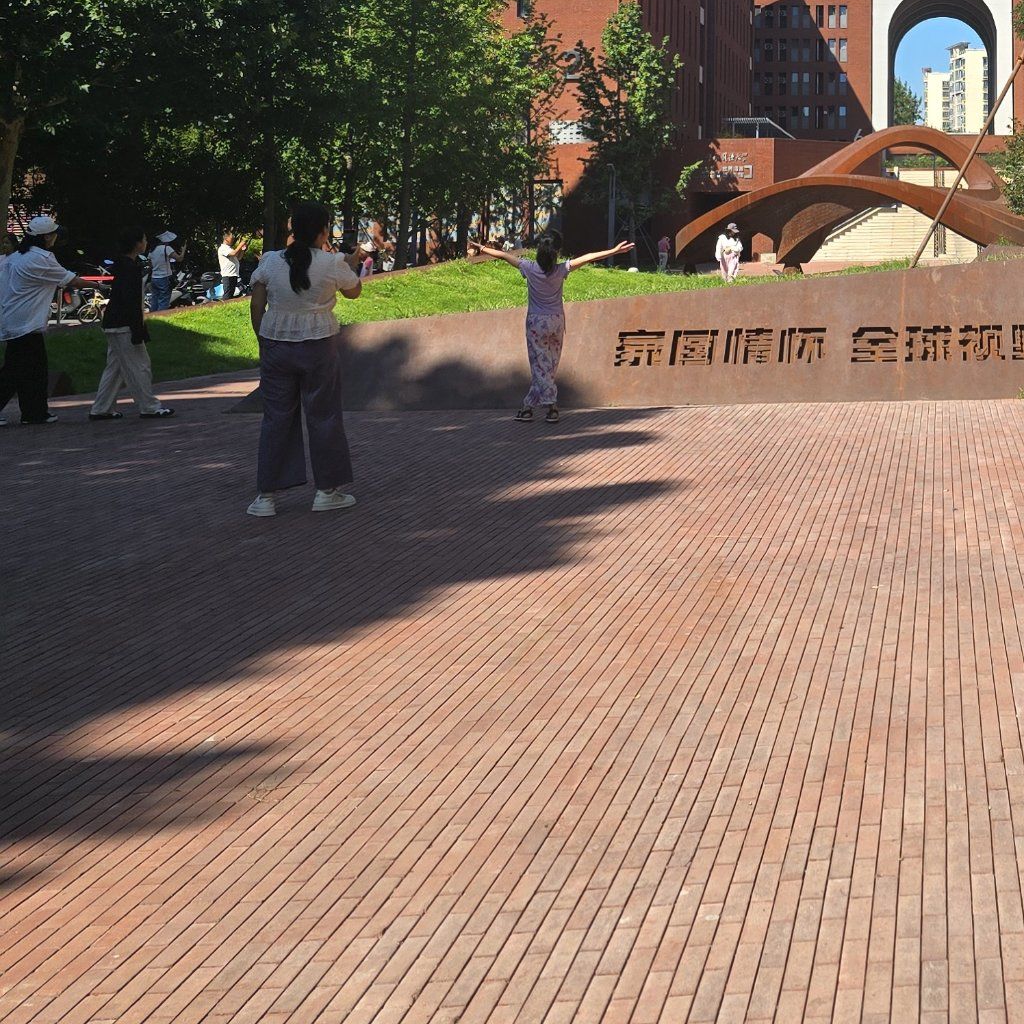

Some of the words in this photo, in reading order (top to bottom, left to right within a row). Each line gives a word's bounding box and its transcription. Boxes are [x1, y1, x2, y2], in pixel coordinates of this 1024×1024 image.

[563, 50, 583, 80] 2
[613, 327, 828, 367] 家国情怀
